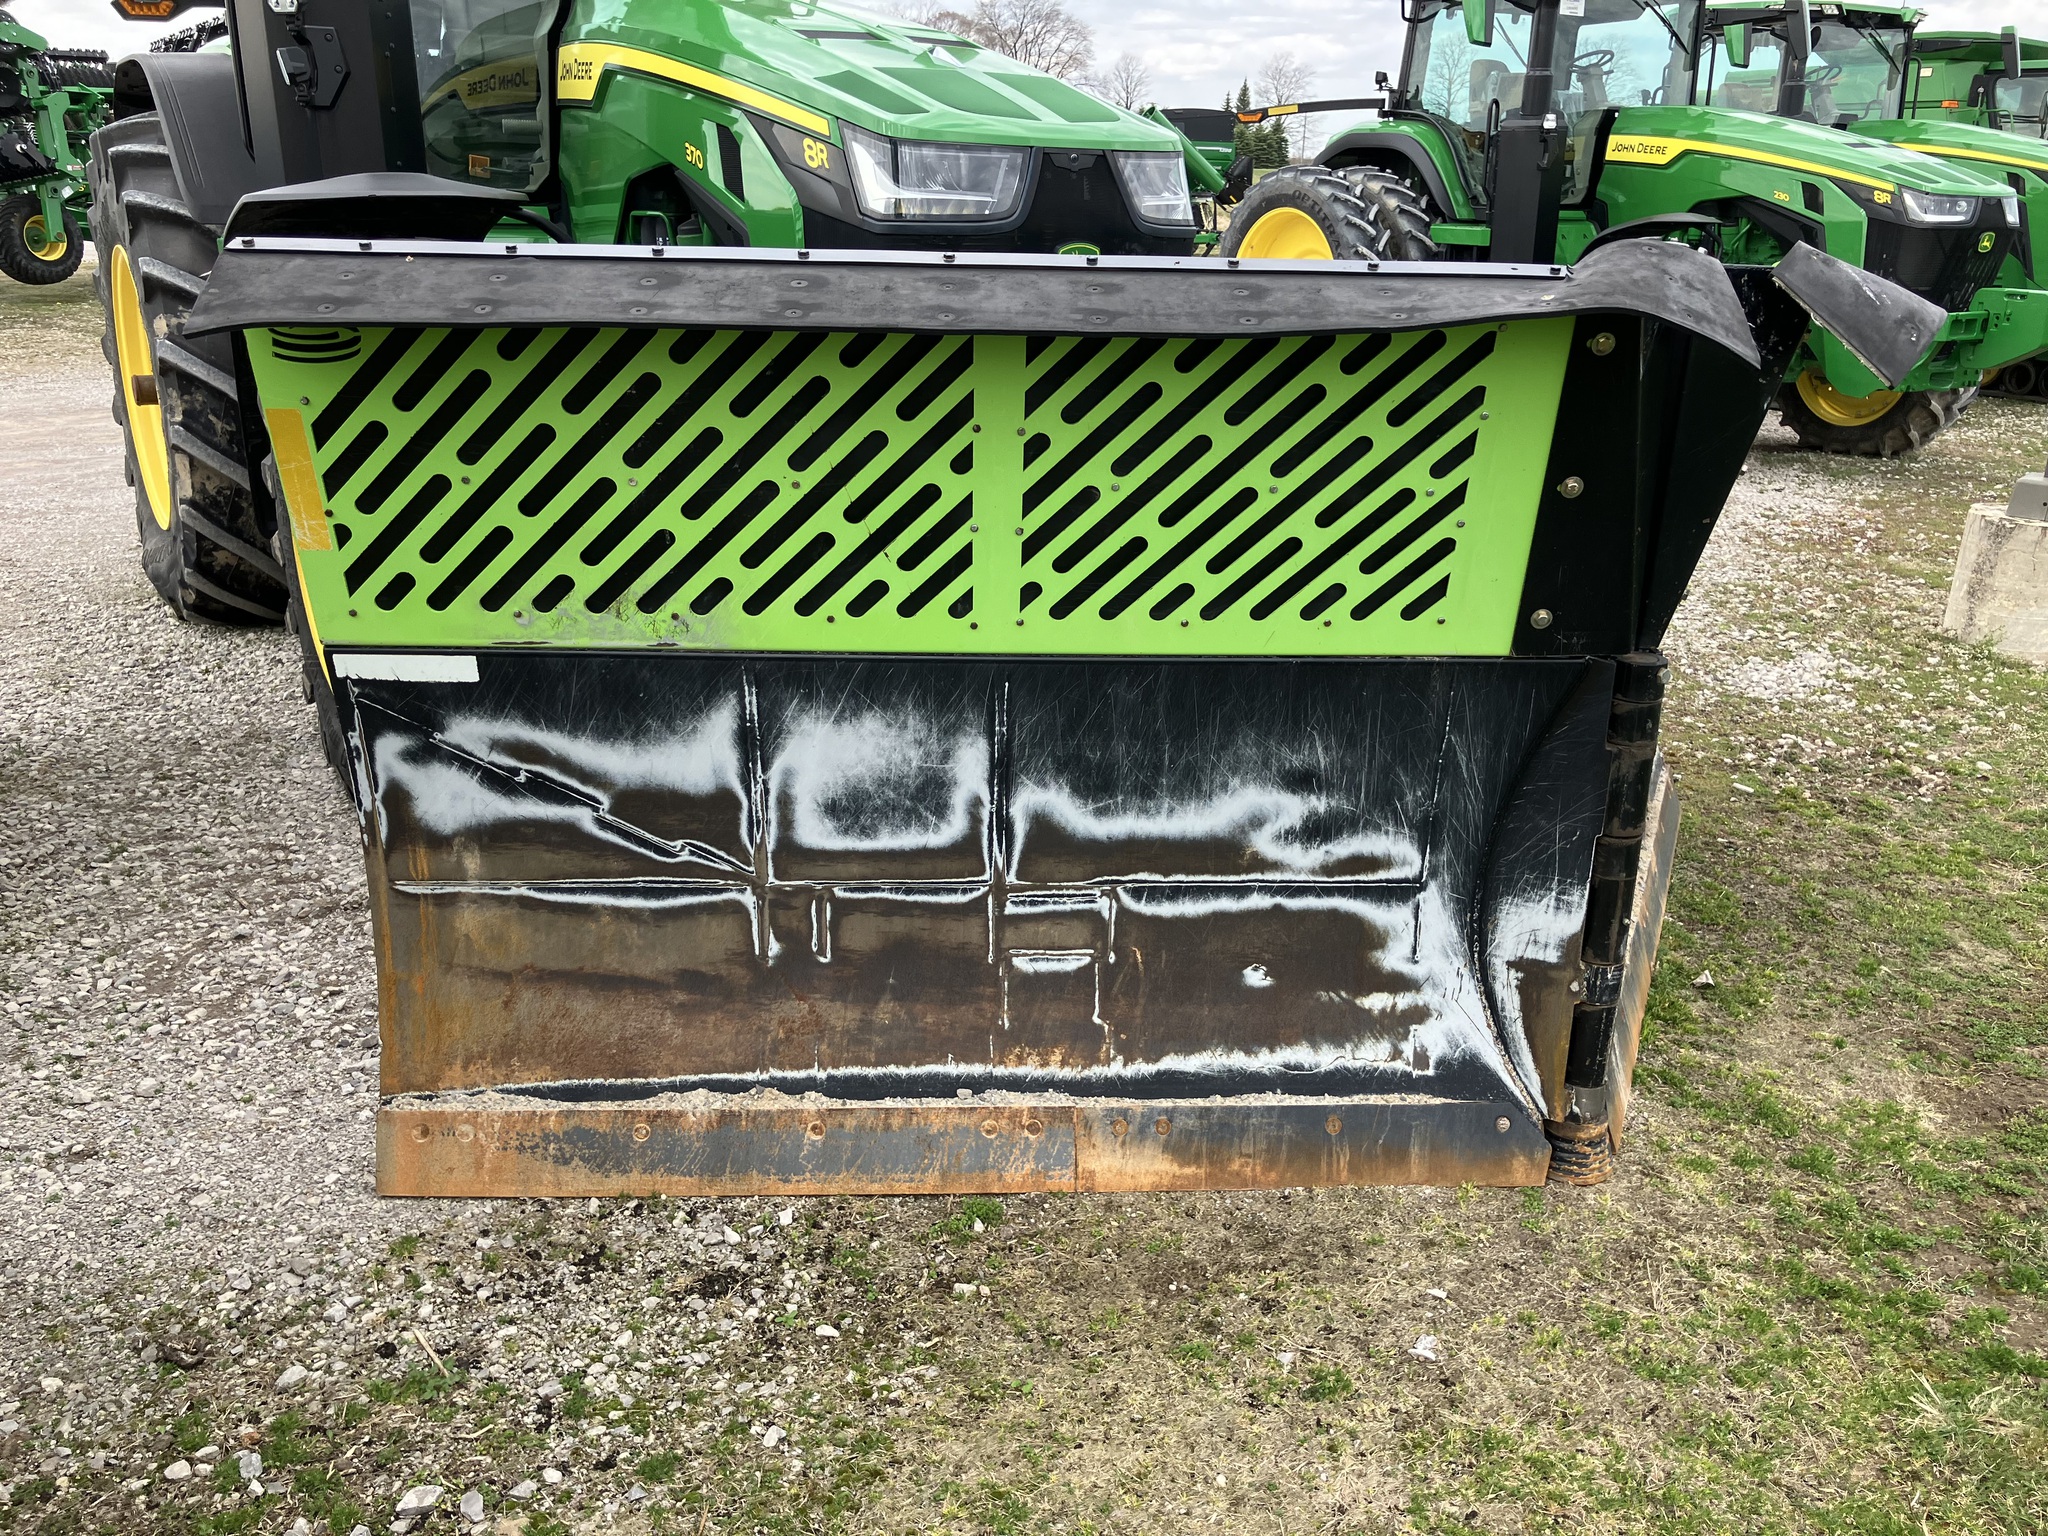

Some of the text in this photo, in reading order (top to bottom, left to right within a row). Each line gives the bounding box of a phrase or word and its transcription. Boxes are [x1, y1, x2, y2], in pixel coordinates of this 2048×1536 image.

[559, 58, 593, 81] JOHN DEERE
[684, 141, 704, 170] 370
[802, 137, 830, 169] 8R
[1611, 141, 1668, 155] JOHN DEERE
[1773, 190, 1790, 202] 230
[1873, 190, 1892, 205] 8R
